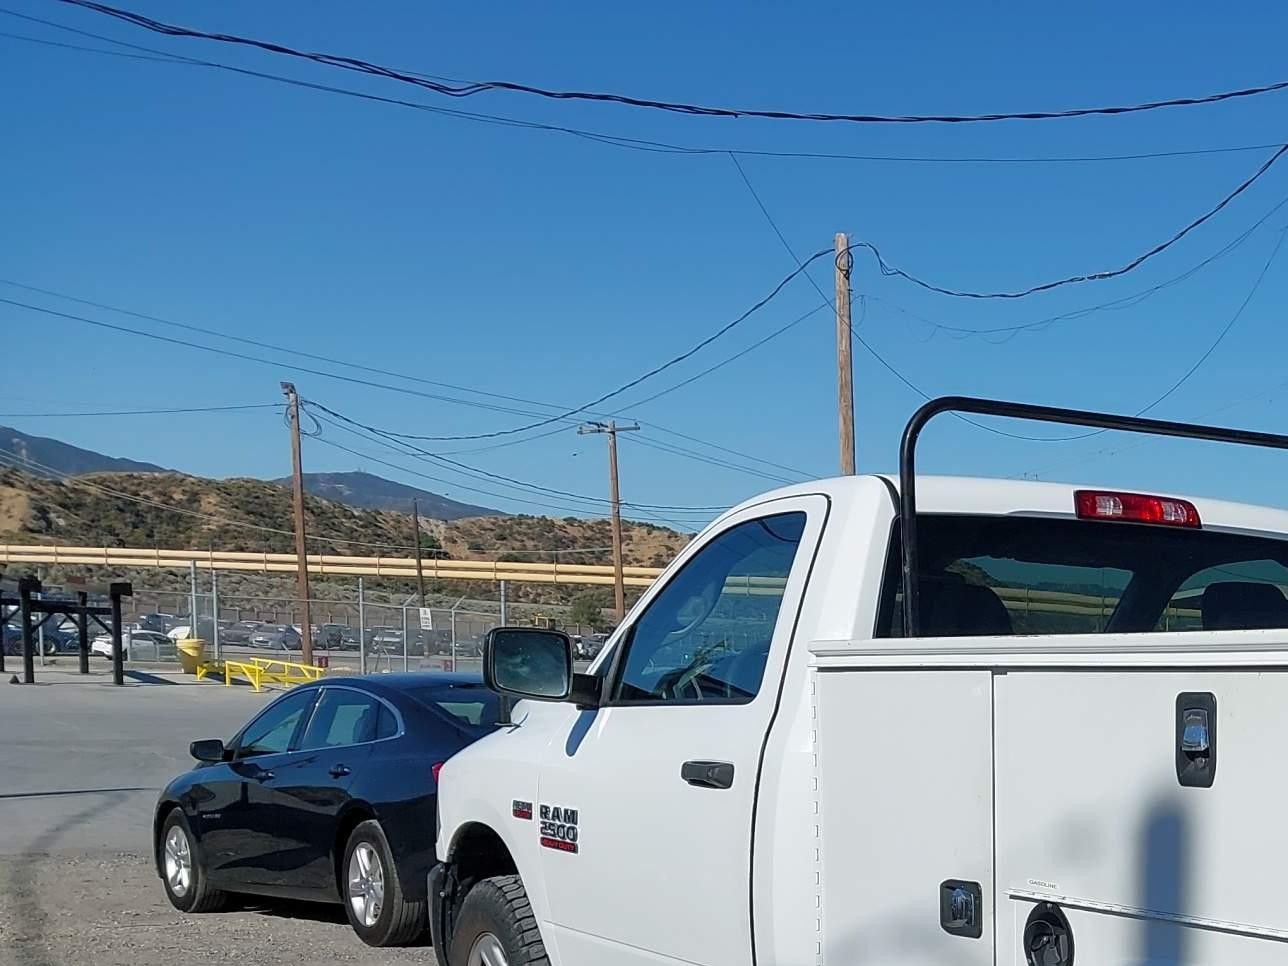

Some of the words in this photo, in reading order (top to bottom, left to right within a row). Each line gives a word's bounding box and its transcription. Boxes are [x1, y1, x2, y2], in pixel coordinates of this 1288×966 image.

[540, 804, 578, 825] RAM
[540, 821, 578, 842] 2500
[1029, 879, 1057, 889] GASOLINE
